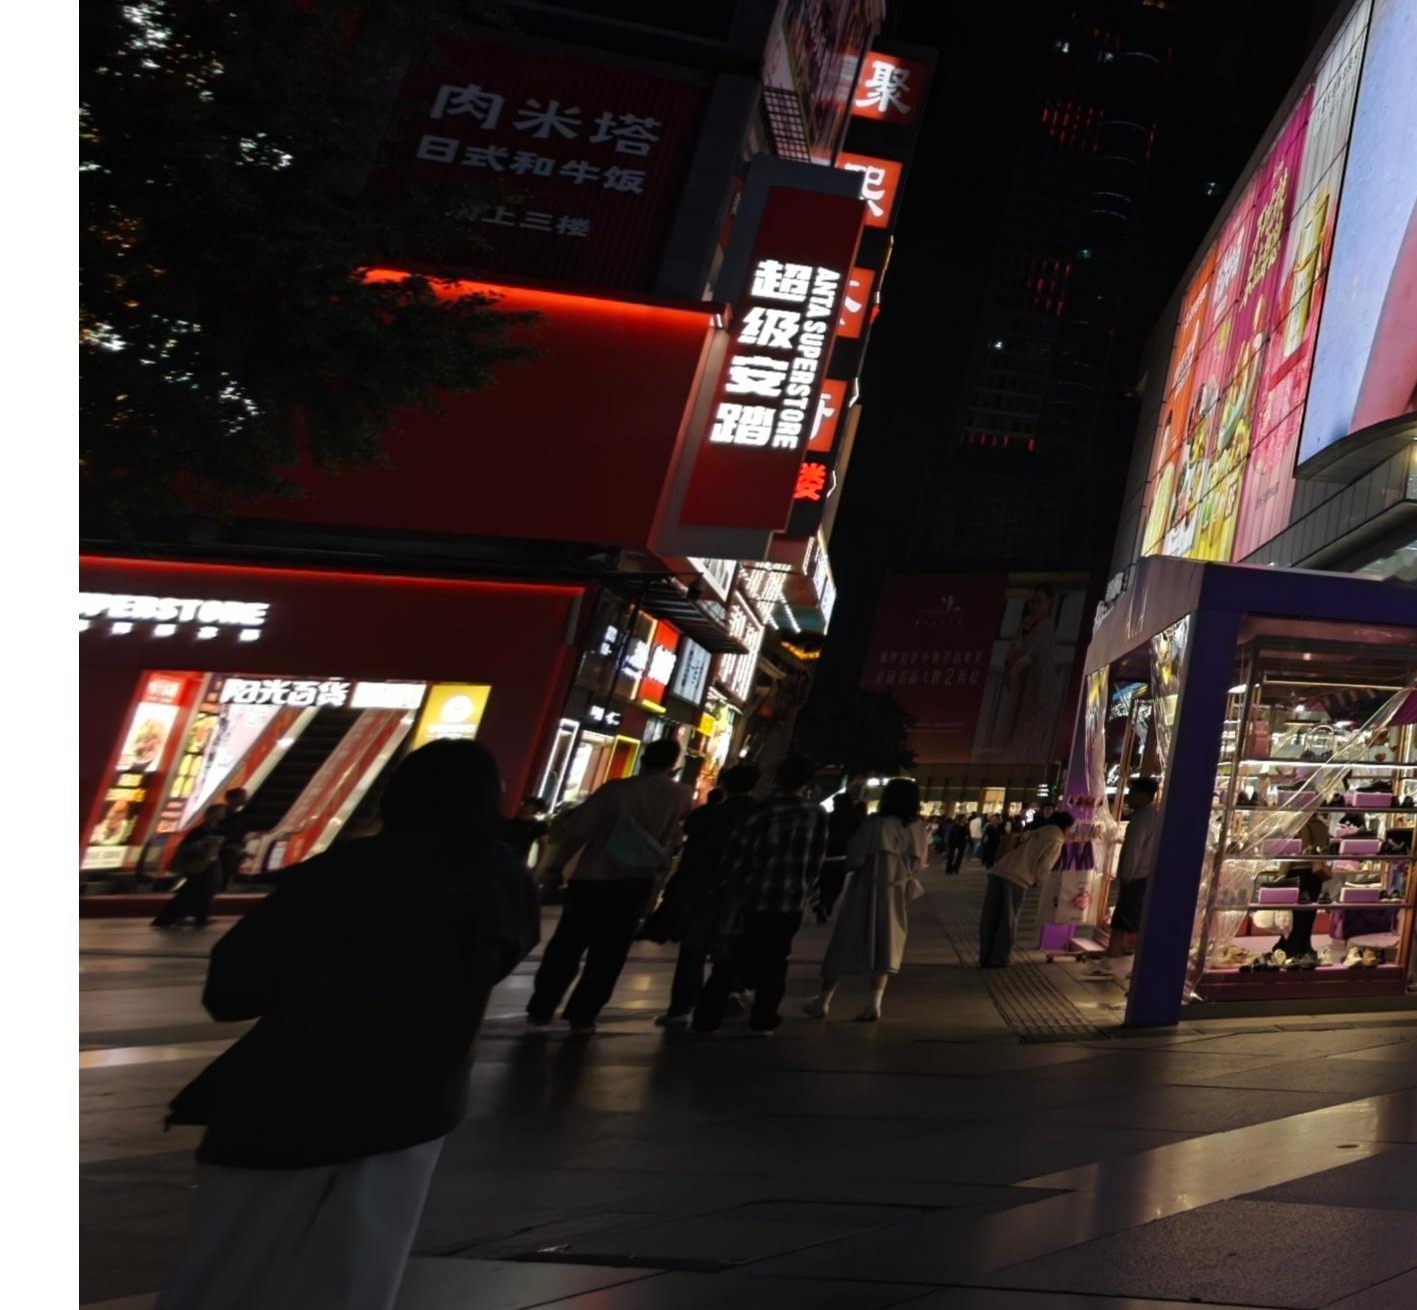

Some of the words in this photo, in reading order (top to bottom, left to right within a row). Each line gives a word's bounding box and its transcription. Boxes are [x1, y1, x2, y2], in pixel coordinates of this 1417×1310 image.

[430, 84, 663, 157] 肉米塔
[416, 134, 647, 195] 日式和牛饭
[806, 266, 841, 319] ANTA
[709, 259, 816, 449] 超级安踏
[771, 319, 826, 450] SUPERSTORE
[219, 677, 352, 708] 阳光百货
